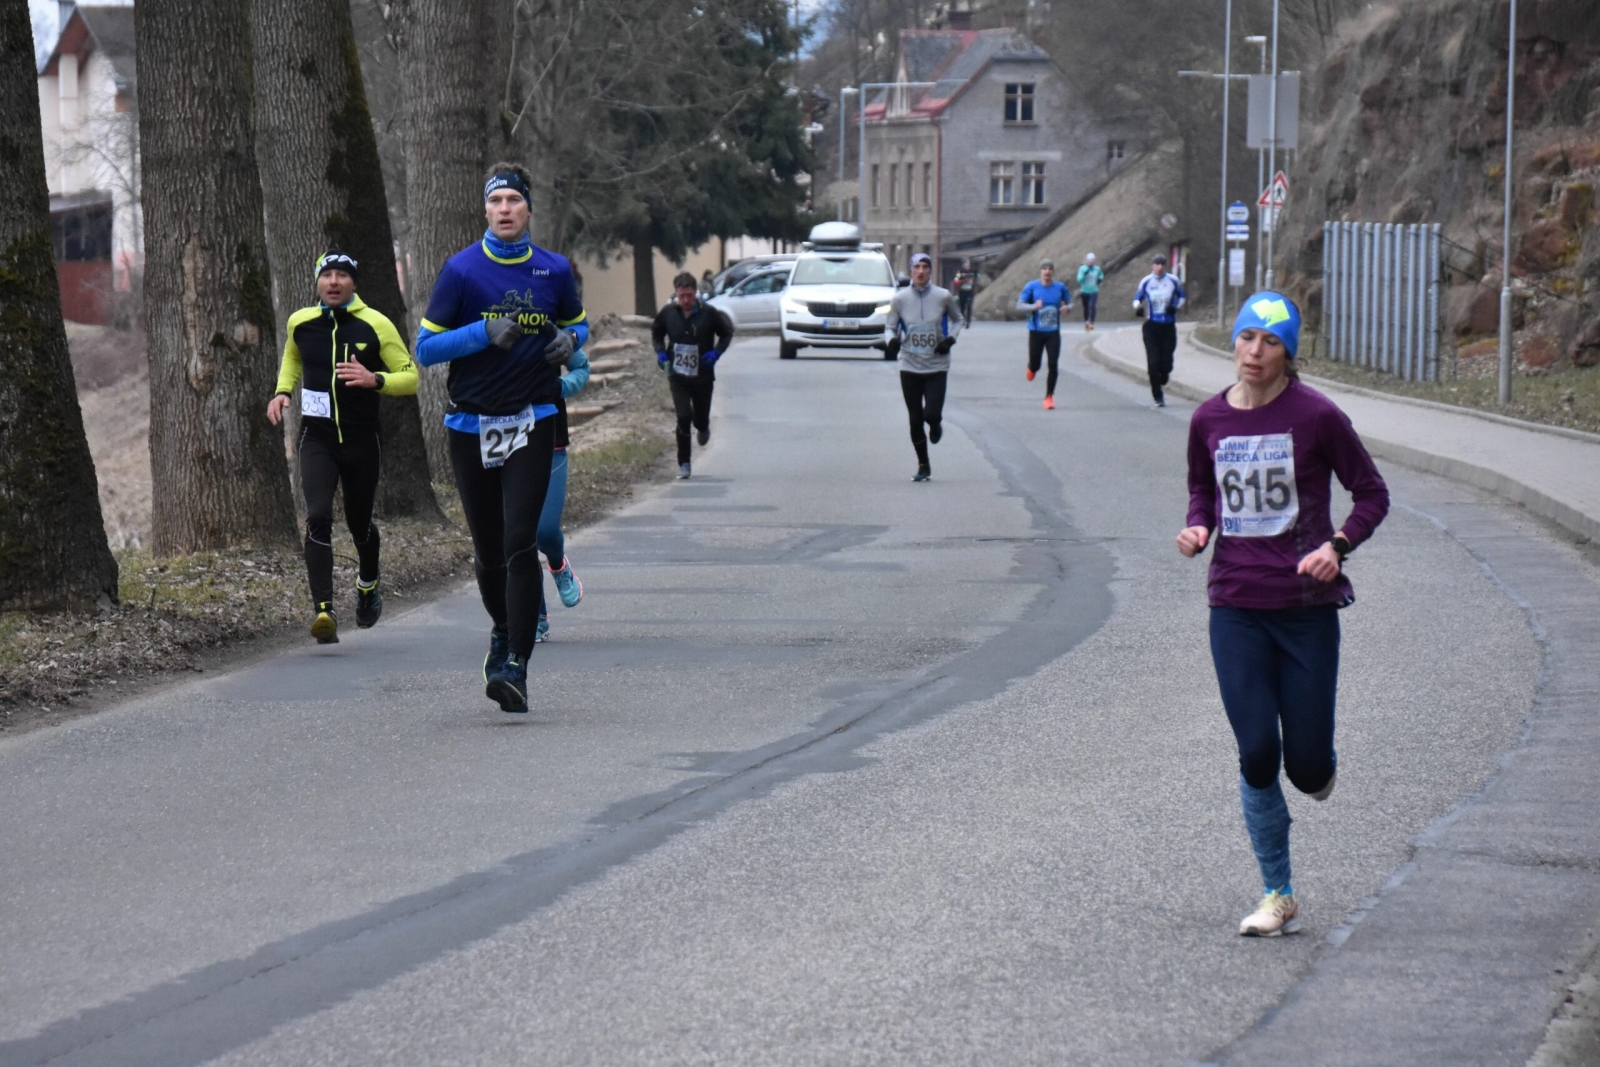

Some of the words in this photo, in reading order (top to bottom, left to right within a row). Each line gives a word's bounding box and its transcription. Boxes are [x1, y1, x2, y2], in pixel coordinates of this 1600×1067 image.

[911, 333, 936, 348] 656
[675, 353, 698, 369] 243
[302, 392, 328, 416] 635
[514, 411, 531, 421] LIGA
[1217, 451, 1259, 462] BĚŽECÁ
[1264, 450, 1289, 461] LIGA
[1222, 466, 1291, 513] 615
